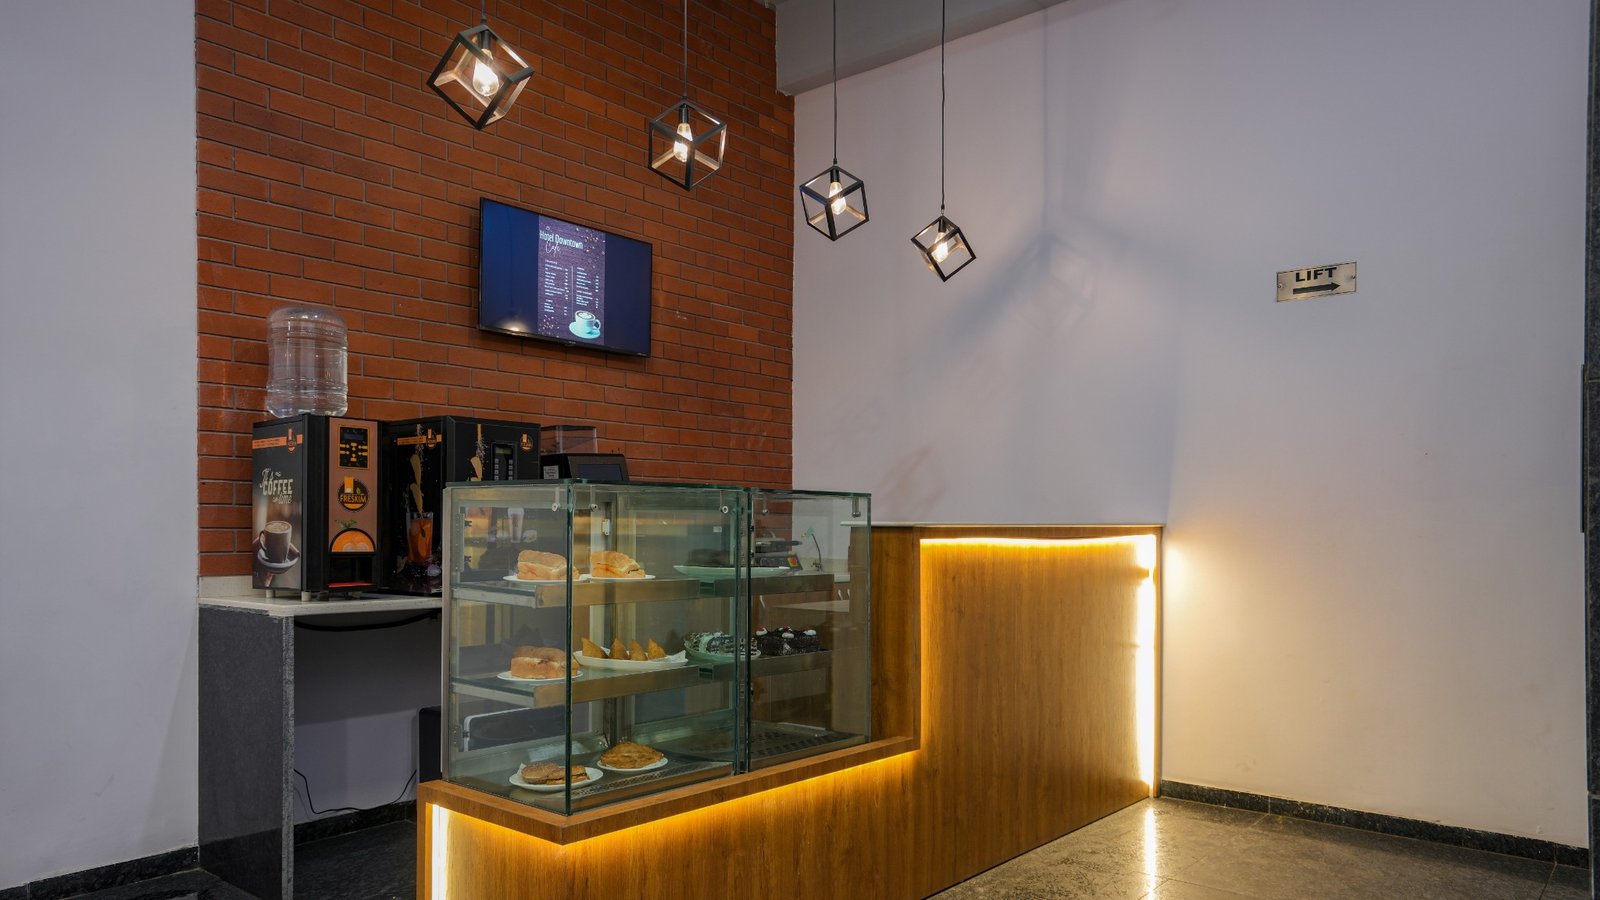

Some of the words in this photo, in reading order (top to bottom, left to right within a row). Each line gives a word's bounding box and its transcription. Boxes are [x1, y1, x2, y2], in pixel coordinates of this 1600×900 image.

[540, 230, 554, 242] Hotel
[555, 234, 584, 249] Downtown
[1295, 267, 1337, 282] LIFT
[262, 479, 293, 495] COFFEE
[340, 494, 367, 503] FRESKIM
